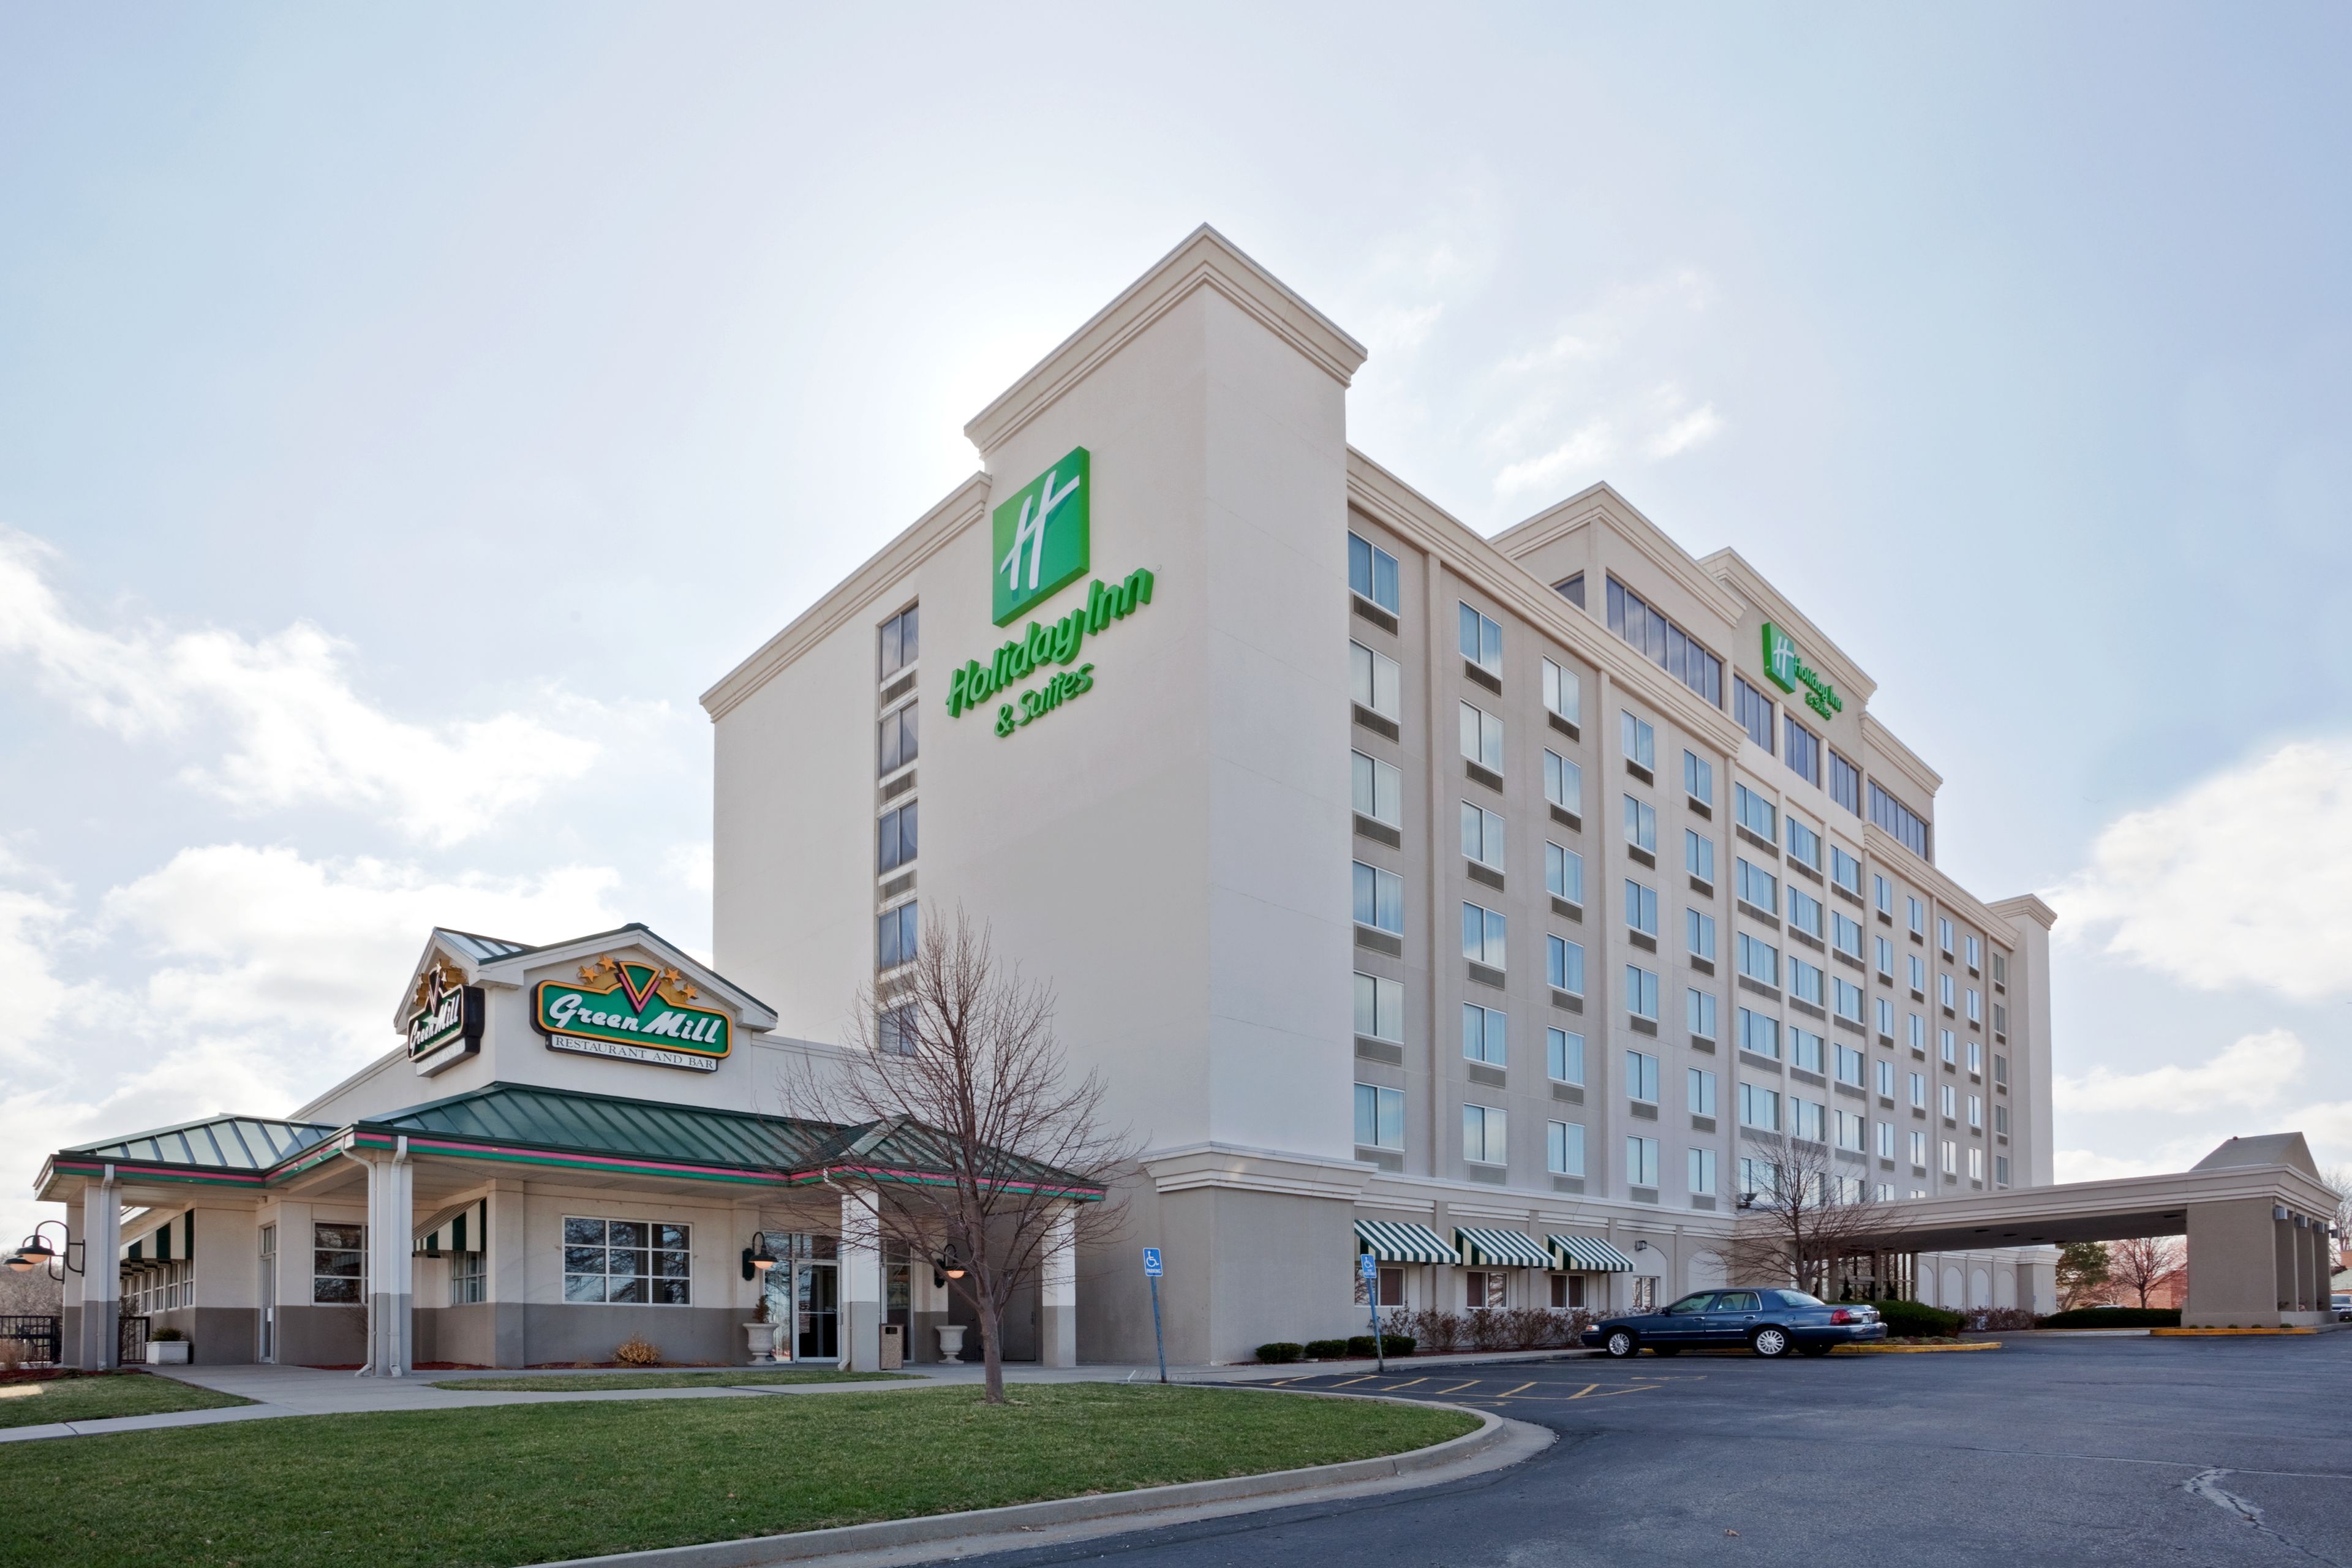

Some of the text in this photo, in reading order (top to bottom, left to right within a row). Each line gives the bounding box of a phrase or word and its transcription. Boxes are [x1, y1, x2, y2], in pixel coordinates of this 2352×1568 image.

[1000, 470, 1080, 591] H
[945, 567, 1154, 718] Holiday Inn
[994, 663, 1095, 738] & Suites
[1793, 654, 1842, 713] Holiday Inn
[410, 993, 461, 1057] Green Mill
[549, 993, 723, 1044] Green Mill
[556, 1036, 714, 1069] RESTAURANT AND BAR
